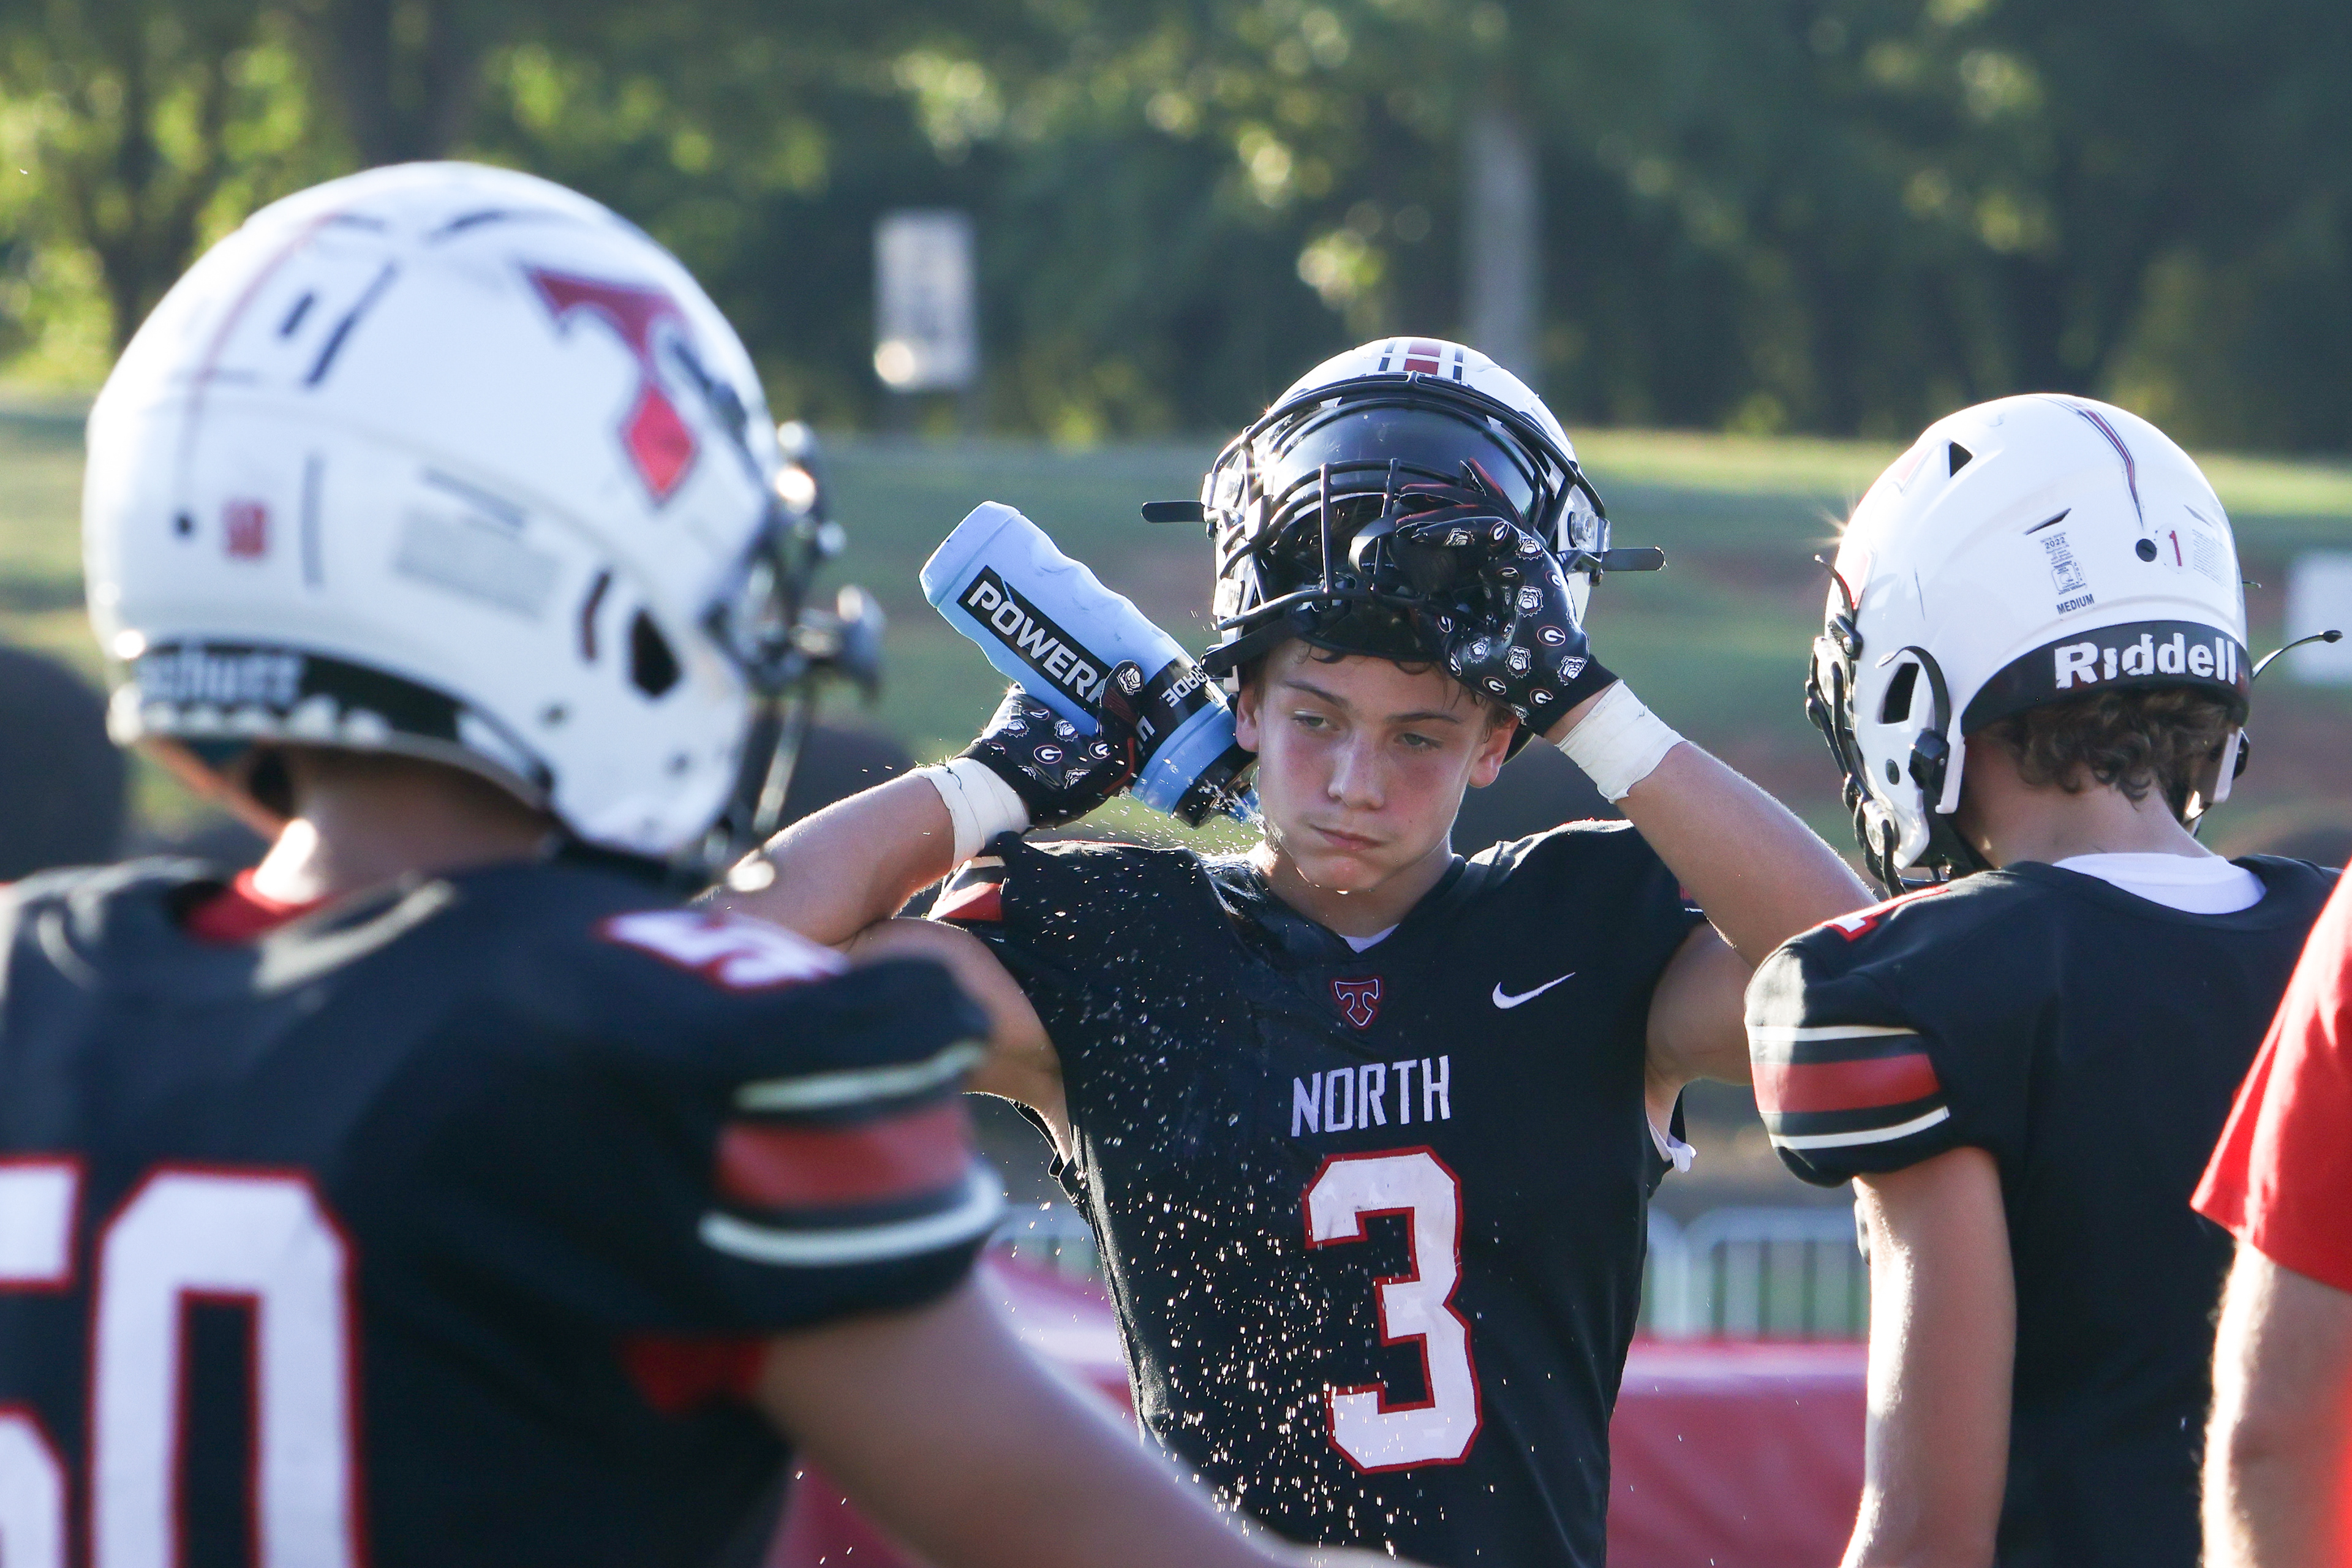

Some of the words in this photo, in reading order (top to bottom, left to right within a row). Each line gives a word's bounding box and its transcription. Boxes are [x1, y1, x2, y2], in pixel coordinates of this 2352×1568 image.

[2045, 537, 2066, 549] 2022
[2168, 530, 2182, 567] 1
[2056, 593, 2095, 615] MEDIUM
[2054, 632, 2237, 690] Riddell
[1291, 1055, 1451, 1137] NORTH
[1301, 1145, 1483, 1474] 3
